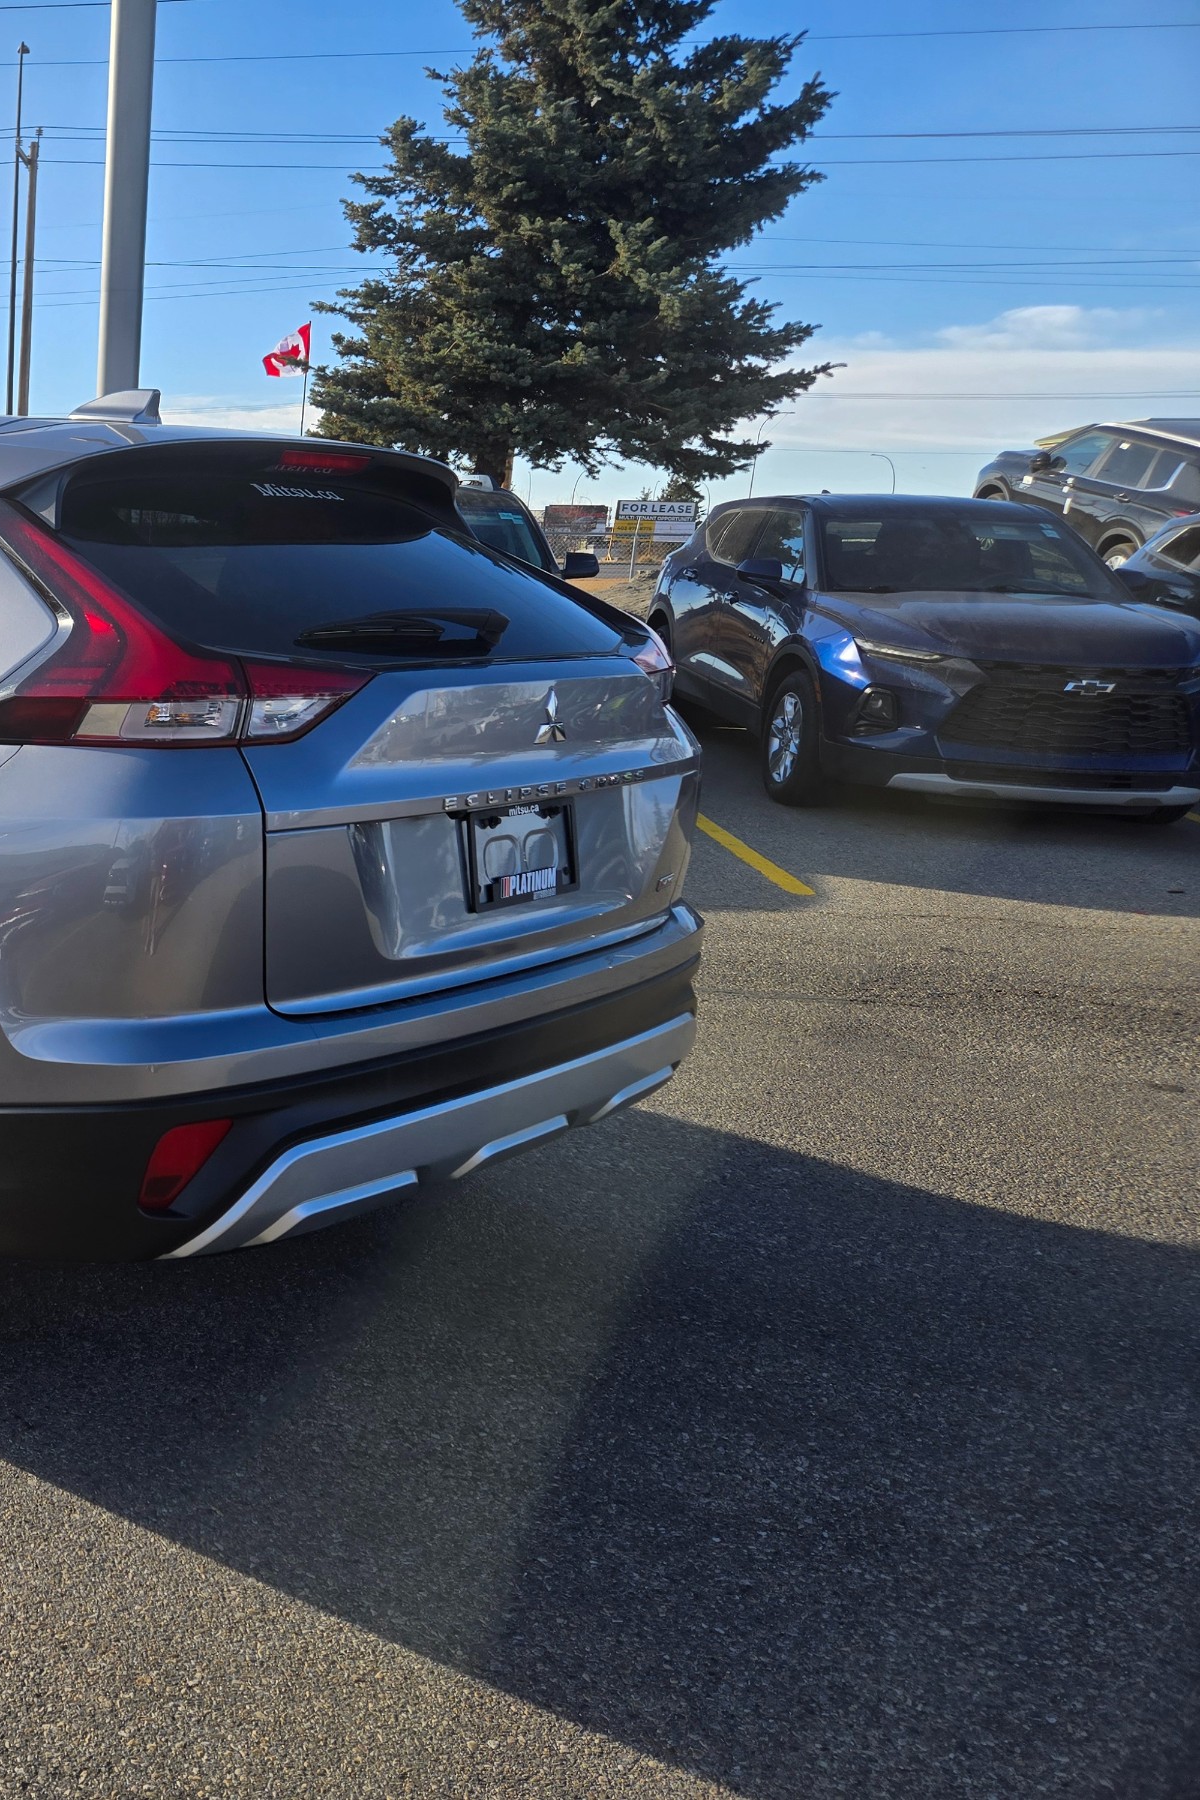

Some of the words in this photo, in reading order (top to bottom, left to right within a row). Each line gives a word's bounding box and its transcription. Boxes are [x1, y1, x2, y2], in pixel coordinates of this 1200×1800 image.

[250, 483, 344, 501] Mitsu.ca
[621, 503, 648, 513] FOR
[651, 504, 692, 514] LEASE
[444, 782, 567, 811] ECLIPSE
[578, 769, 645, 791] CROSS
[508, 804, 540, 817] mitsu.ca
[509, 867, 557, 897] PLATINUM
